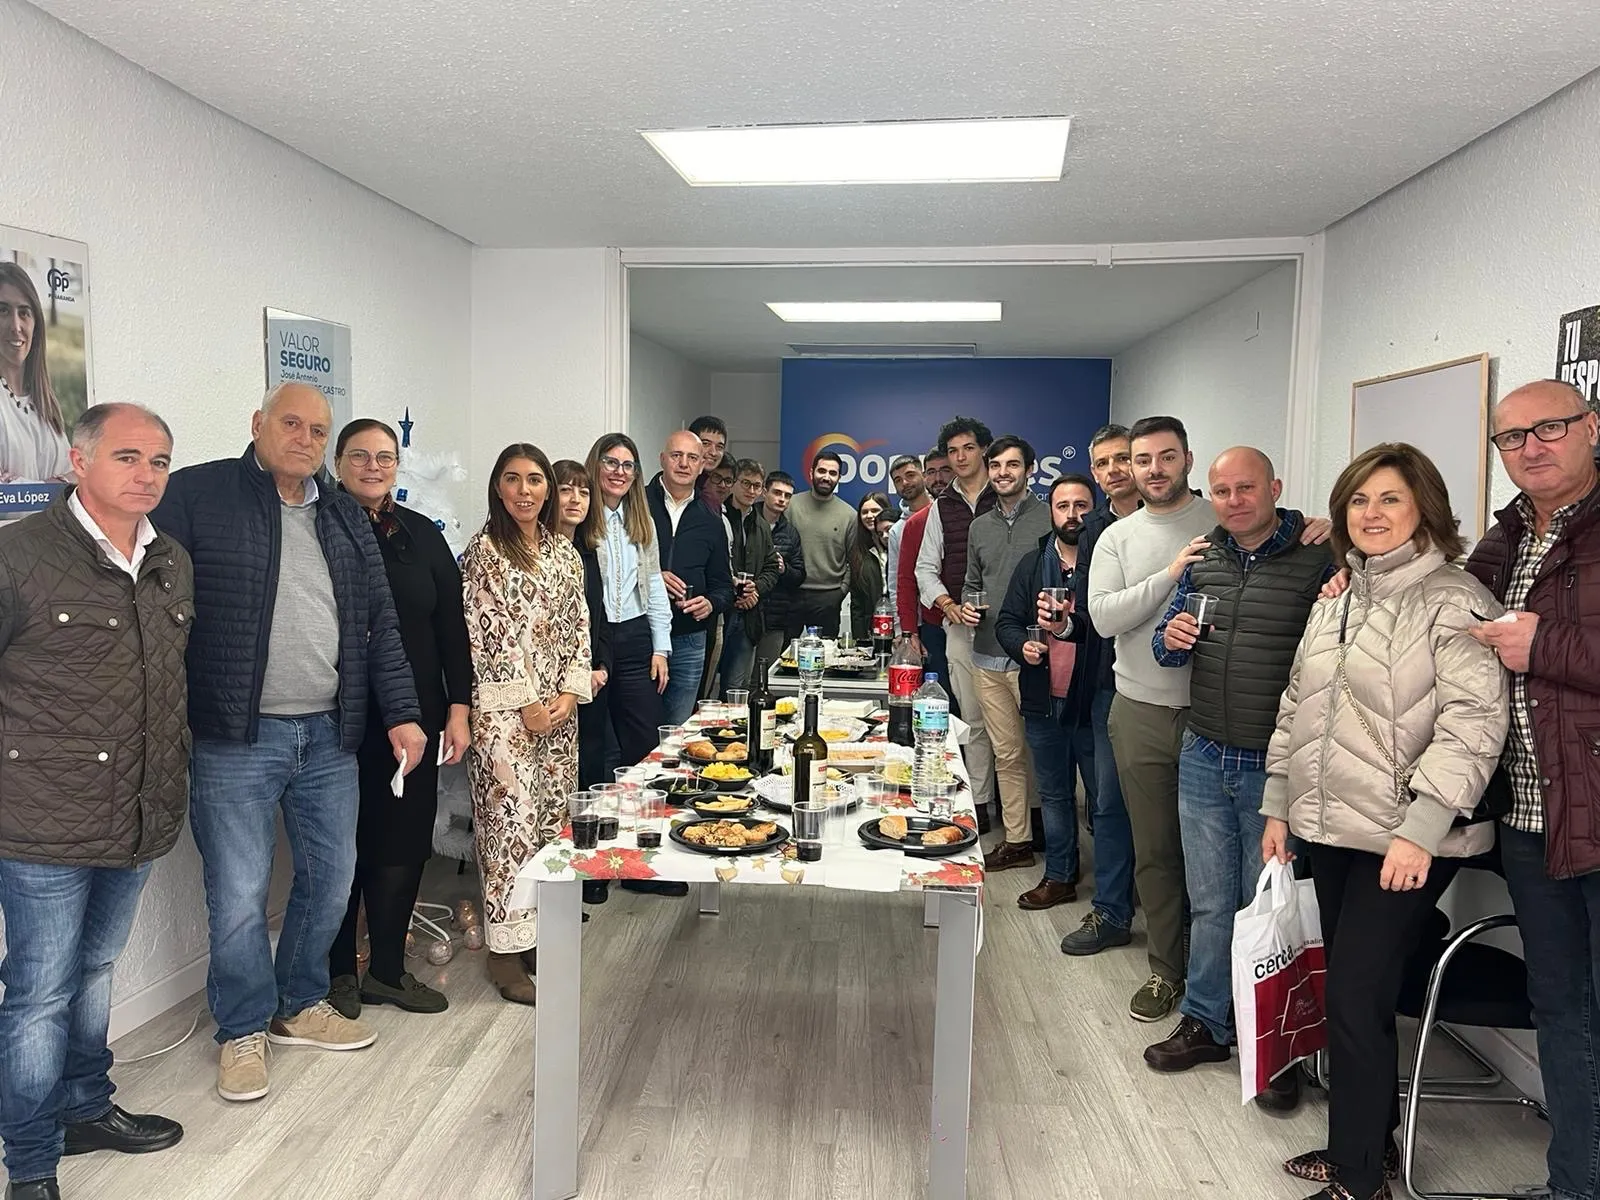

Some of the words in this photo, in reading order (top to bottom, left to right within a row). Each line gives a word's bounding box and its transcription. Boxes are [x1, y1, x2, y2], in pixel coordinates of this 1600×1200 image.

[279, 330, 320, 353] VALOR
[1563, 319, 1582, 363] TU
[280, 350, 331, 373] SEGURO
[322, 385, 346, 397] CASTRO
[17, 490, 51, 505] López
[1254, 944, 1294, 979] cerca
